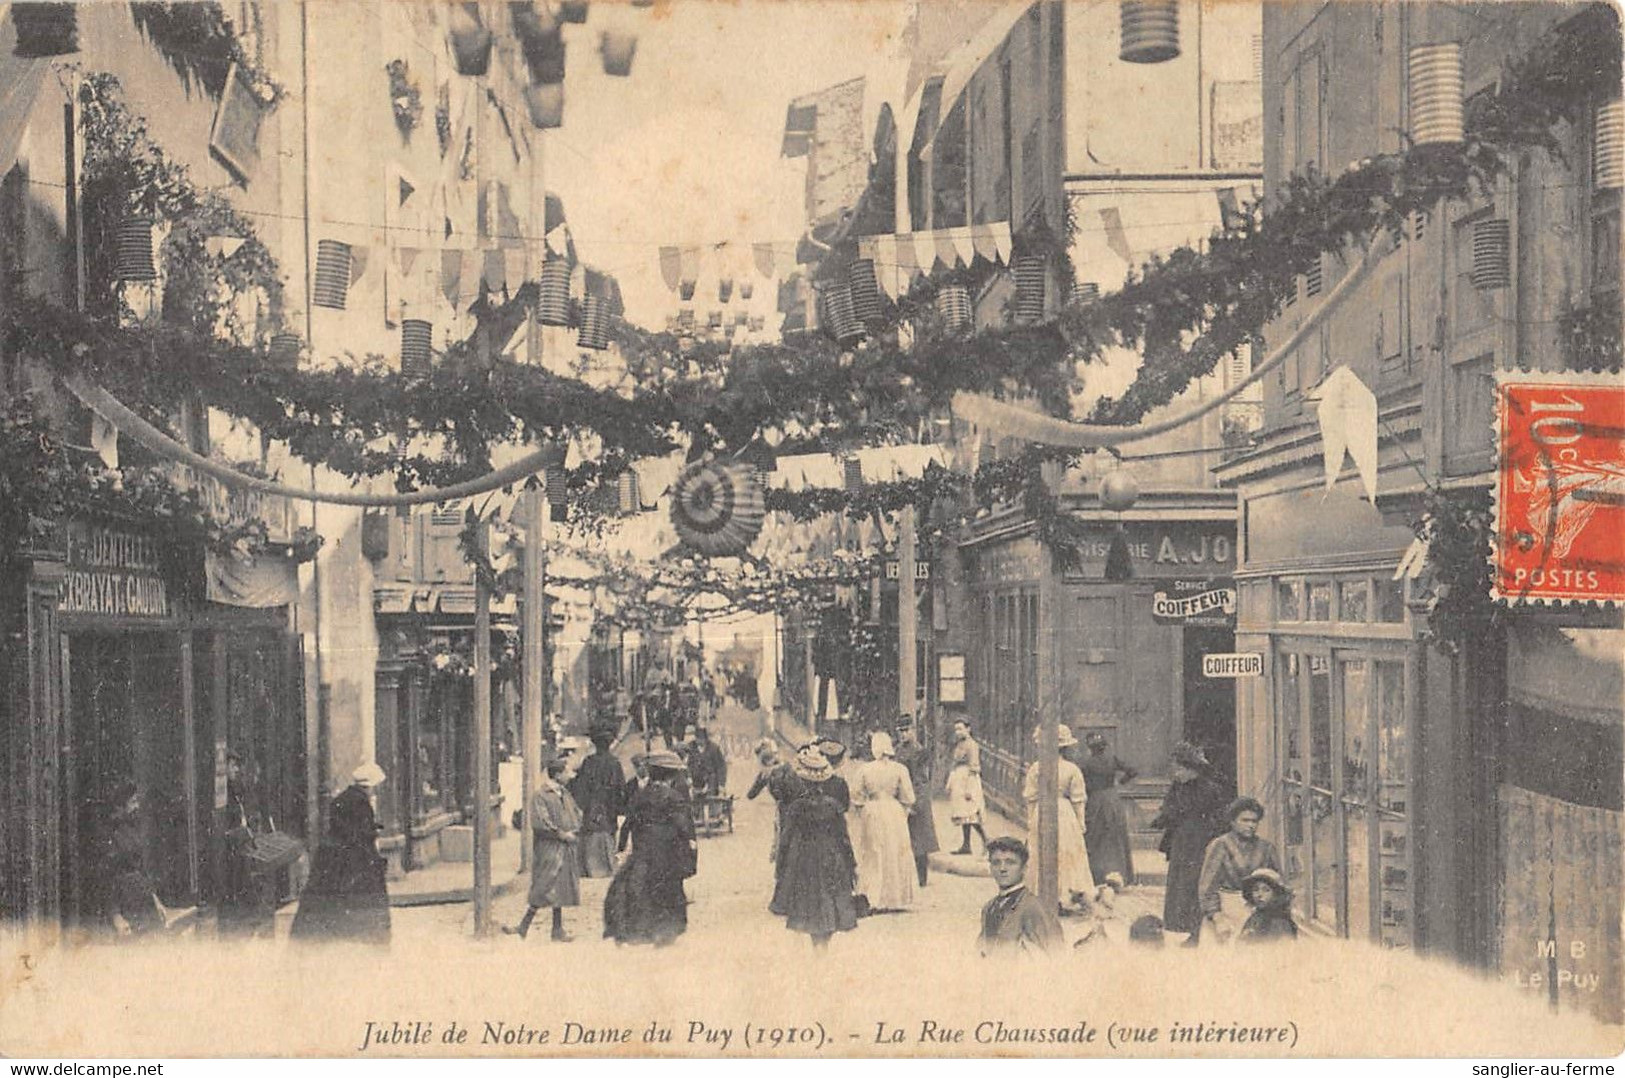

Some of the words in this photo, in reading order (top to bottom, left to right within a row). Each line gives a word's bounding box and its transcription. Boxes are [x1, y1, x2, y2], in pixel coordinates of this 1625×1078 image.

[1514, 568, 1599, 590] POSTES
[1157, 590, 1230, 615] COIFFEUR
[1206, 658, 1259, 674] COIFFEUR
